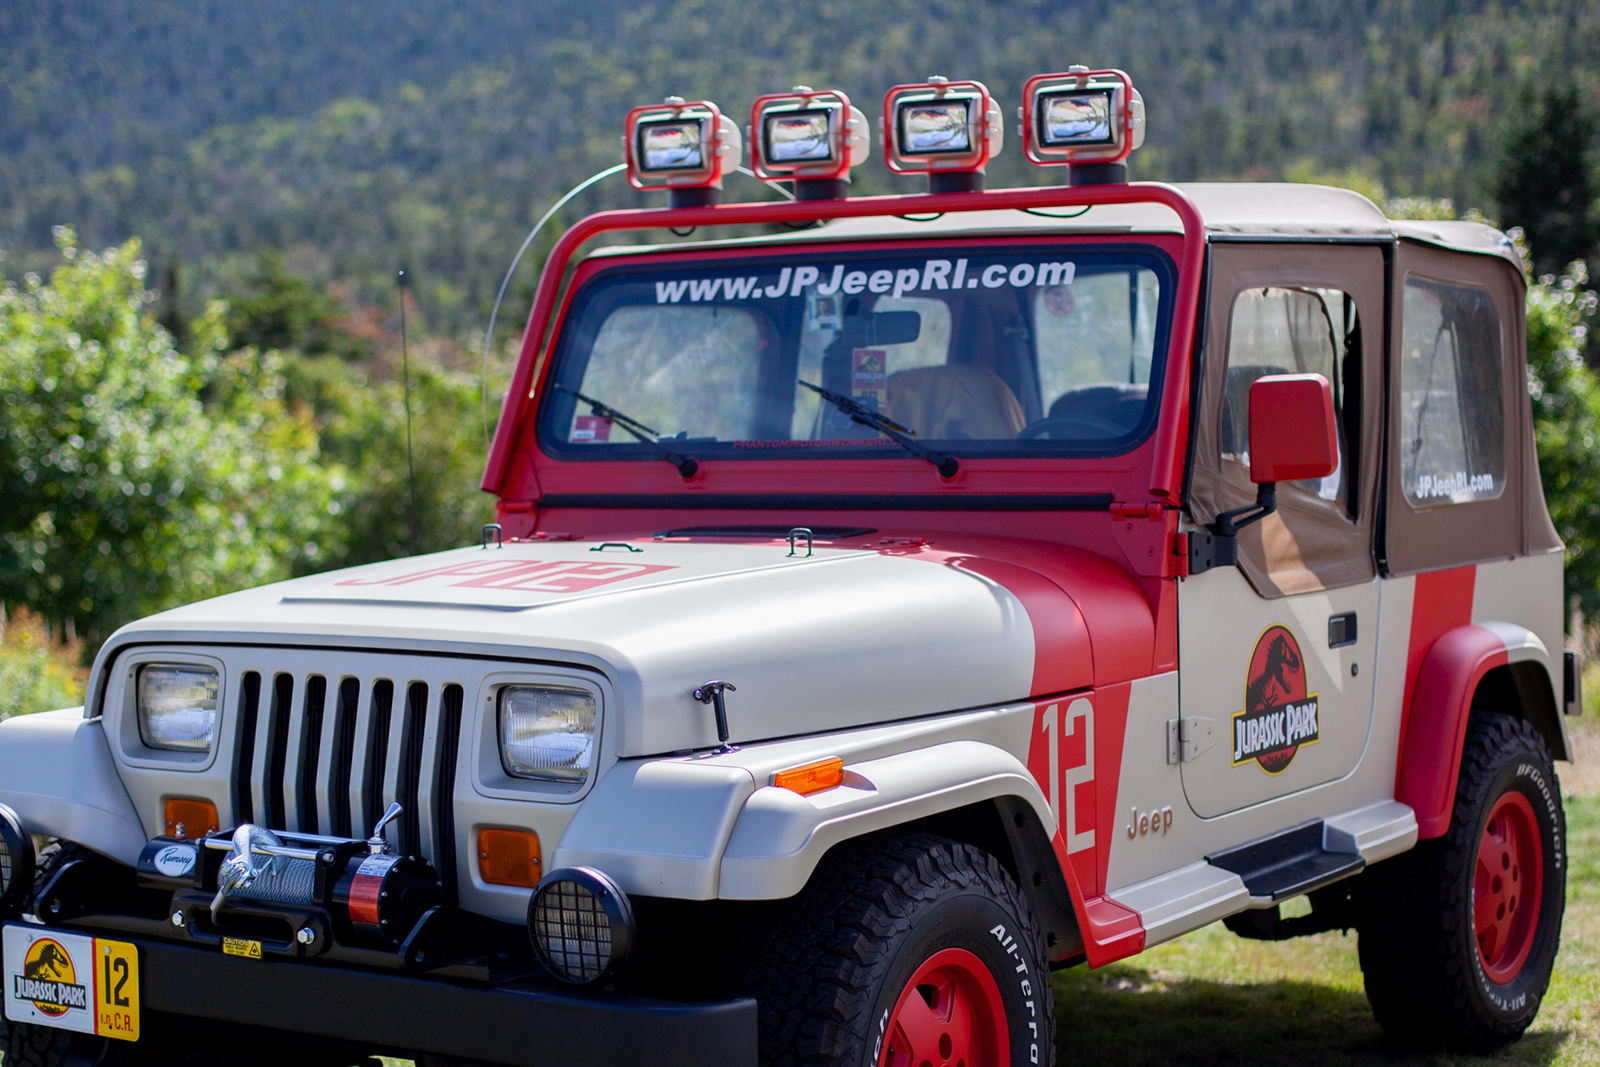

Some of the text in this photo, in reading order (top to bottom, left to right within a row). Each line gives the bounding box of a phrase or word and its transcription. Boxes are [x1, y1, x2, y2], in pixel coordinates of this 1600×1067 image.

[655, 259, 1076, 304] www.JPJeepRI.com
[1416, 471, 1494, 500] JPJeepRI.com
[1235, 702, 1318, 761] JURASSIC PARK
[1042, 697, 1096, 855] 12
[1127, 805, 1173, 839] Jeep
[160, 848, 192, 874] Ramsey
[16, 976, 85, 1006] JURASSIC PARK
[104, 955, 130, 1008] 12
